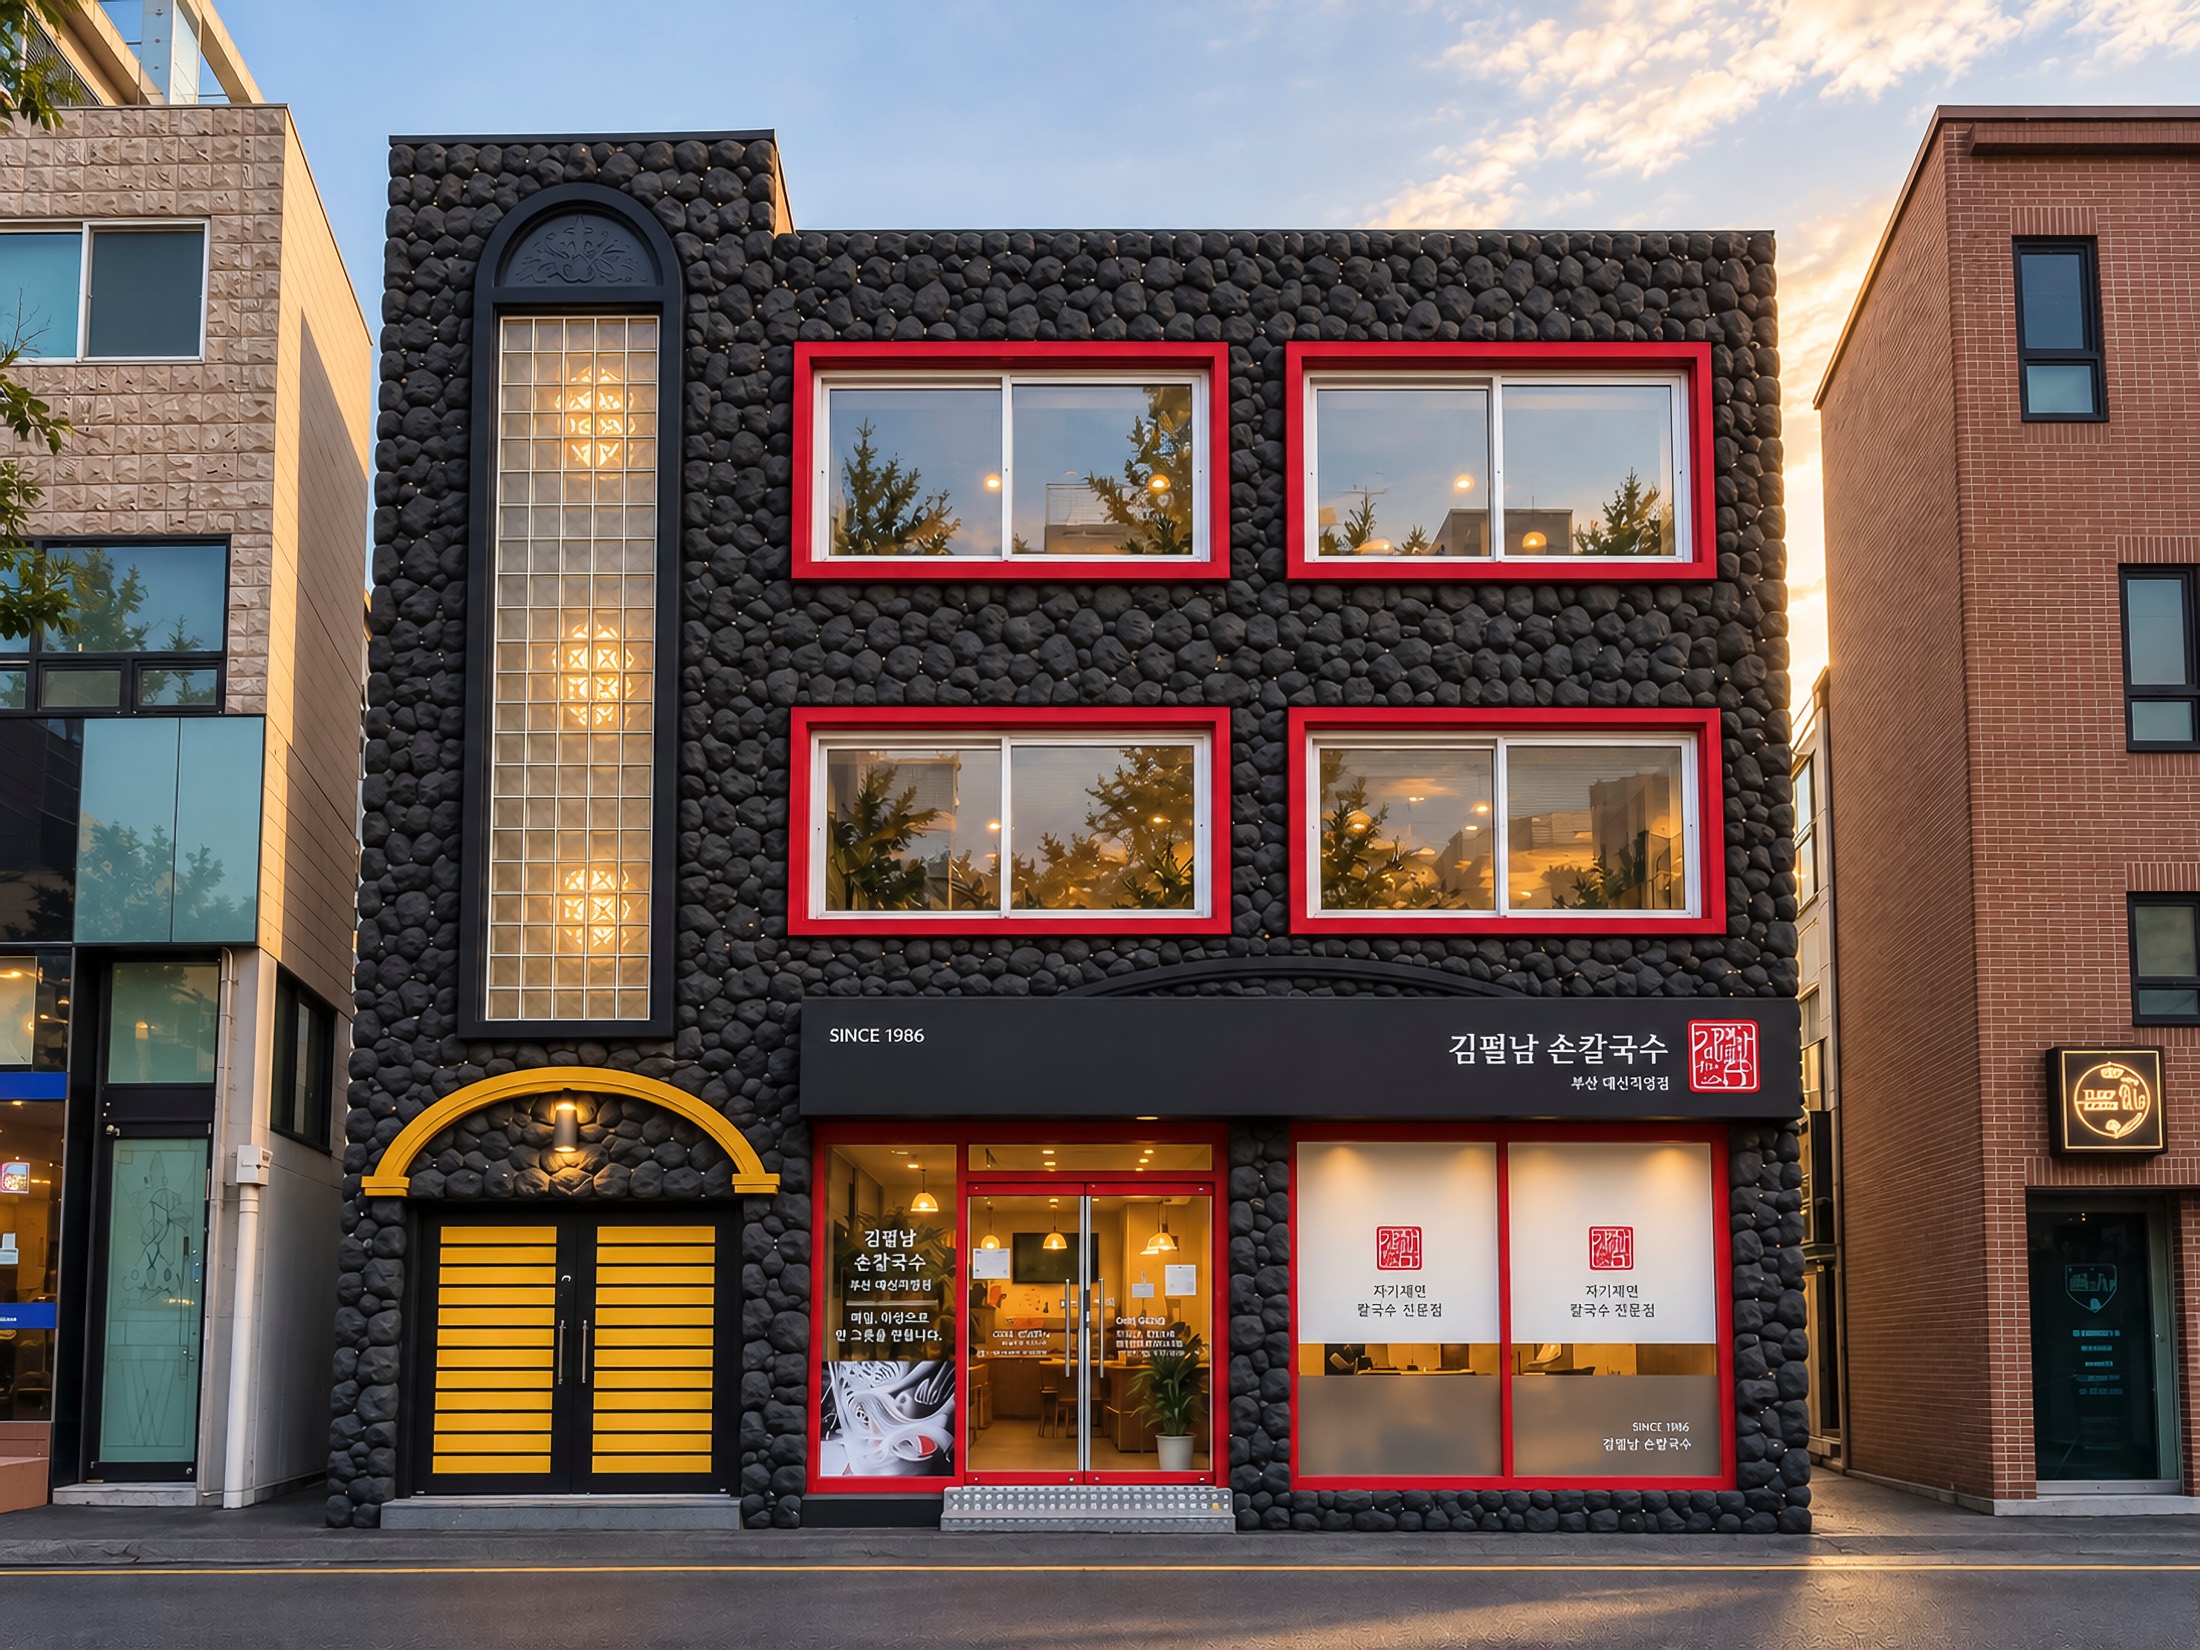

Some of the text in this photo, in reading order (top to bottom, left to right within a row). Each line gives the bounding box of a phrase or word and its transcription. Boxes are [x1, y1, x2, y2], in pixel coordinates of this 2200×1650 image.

[829, 1028, 925, 1043] SINCE 1986
[1547, 1033, 1669, 1065] 손칼국수
[1571, 1075, 1599, 1091] 부산
